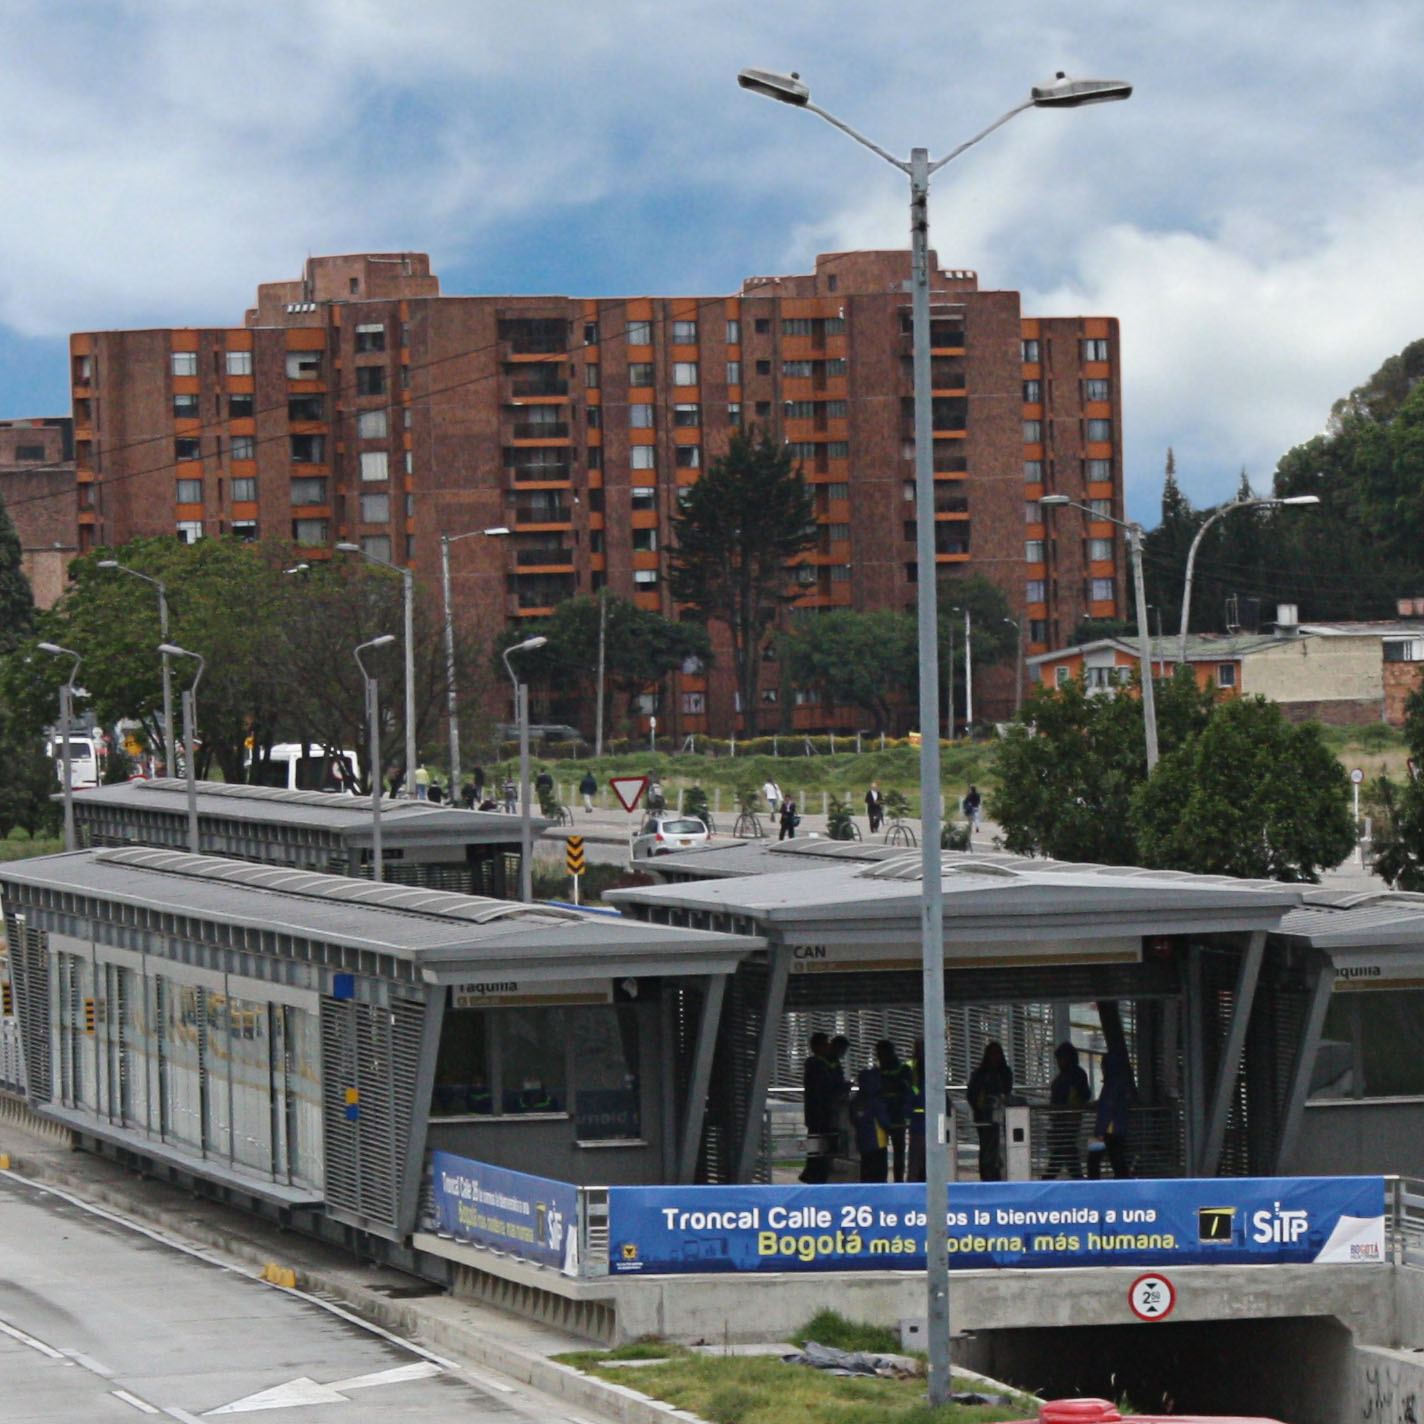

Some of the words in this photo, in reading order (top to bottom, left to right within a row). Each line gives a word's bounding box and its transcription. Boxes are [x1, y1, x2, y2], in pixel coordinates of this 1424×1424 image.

[793, 945, 826, 959] CAN
[662, 1206, 759, 1230] Troncal
[768, 1205, 832, 1229] Calle
[840, 1205, 873, 1228] 26
[879, 1210, 898, 1227] te
[904, 1210, 968, 1227] daos
[974, 1209, 991, 1226] la
[996, 1208, 1100, 1226] bienvenida
[1105, 1210, 1117, 1223] a
[1122, 1209, 1157, 1224] una
[758, 1230, 862, 1262] Bogotá
[869, 1235, 916, 1254] más
[925, 1234, 1026, 1254] oderna,
[1034, 1232, 1080, 1251] más
[1087, 1232, 1180, 1250] humana.
